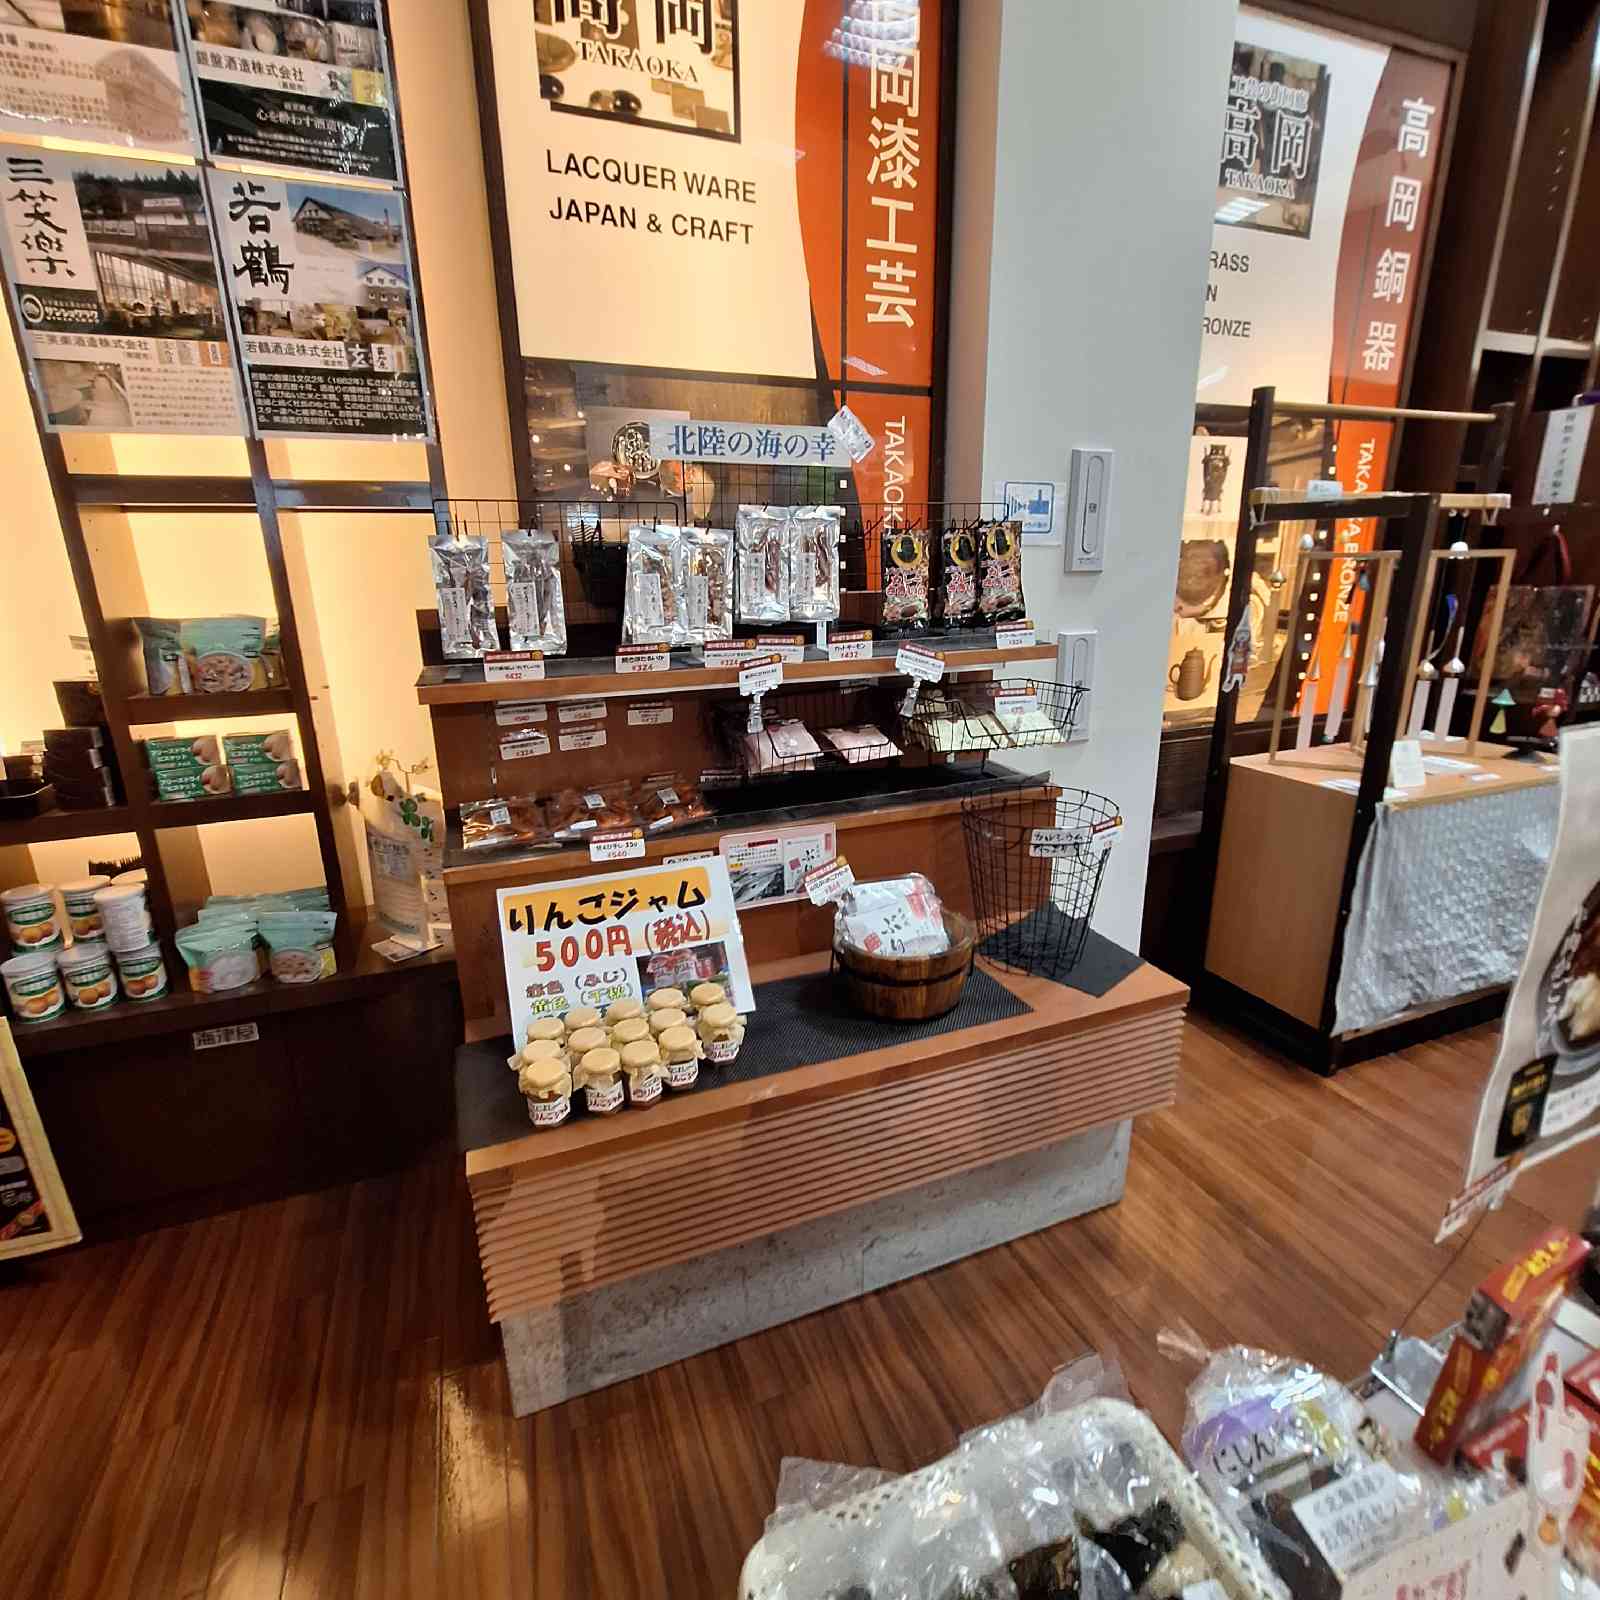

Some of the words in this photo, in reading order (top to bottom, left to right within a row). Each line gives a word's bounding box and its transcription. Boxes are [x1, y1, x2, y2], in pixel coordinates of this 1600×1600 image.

[1221, 98, 1313, 179] 高岡
[546, 149, 677, 191] LACQUER
[683, 171, 757, 204] WARE
[1224, 168, 1297, 200] TAKAOKA
[549, 196, 637, 230] JAPAN
[646, 213, 663, 234] &
[671, 213, 754, 245] CRAFT
[1361, 96, 1436, 371] 高岡銅器
[1209, 250, 1250, 273] RASS
[1202, 317, 1252, 339] RONZE
[666, 423, 836, 462] 北陸の海の幸
[883, 415, 906, 529] TAKAOK
[536, 925, 632, 972] 500円
